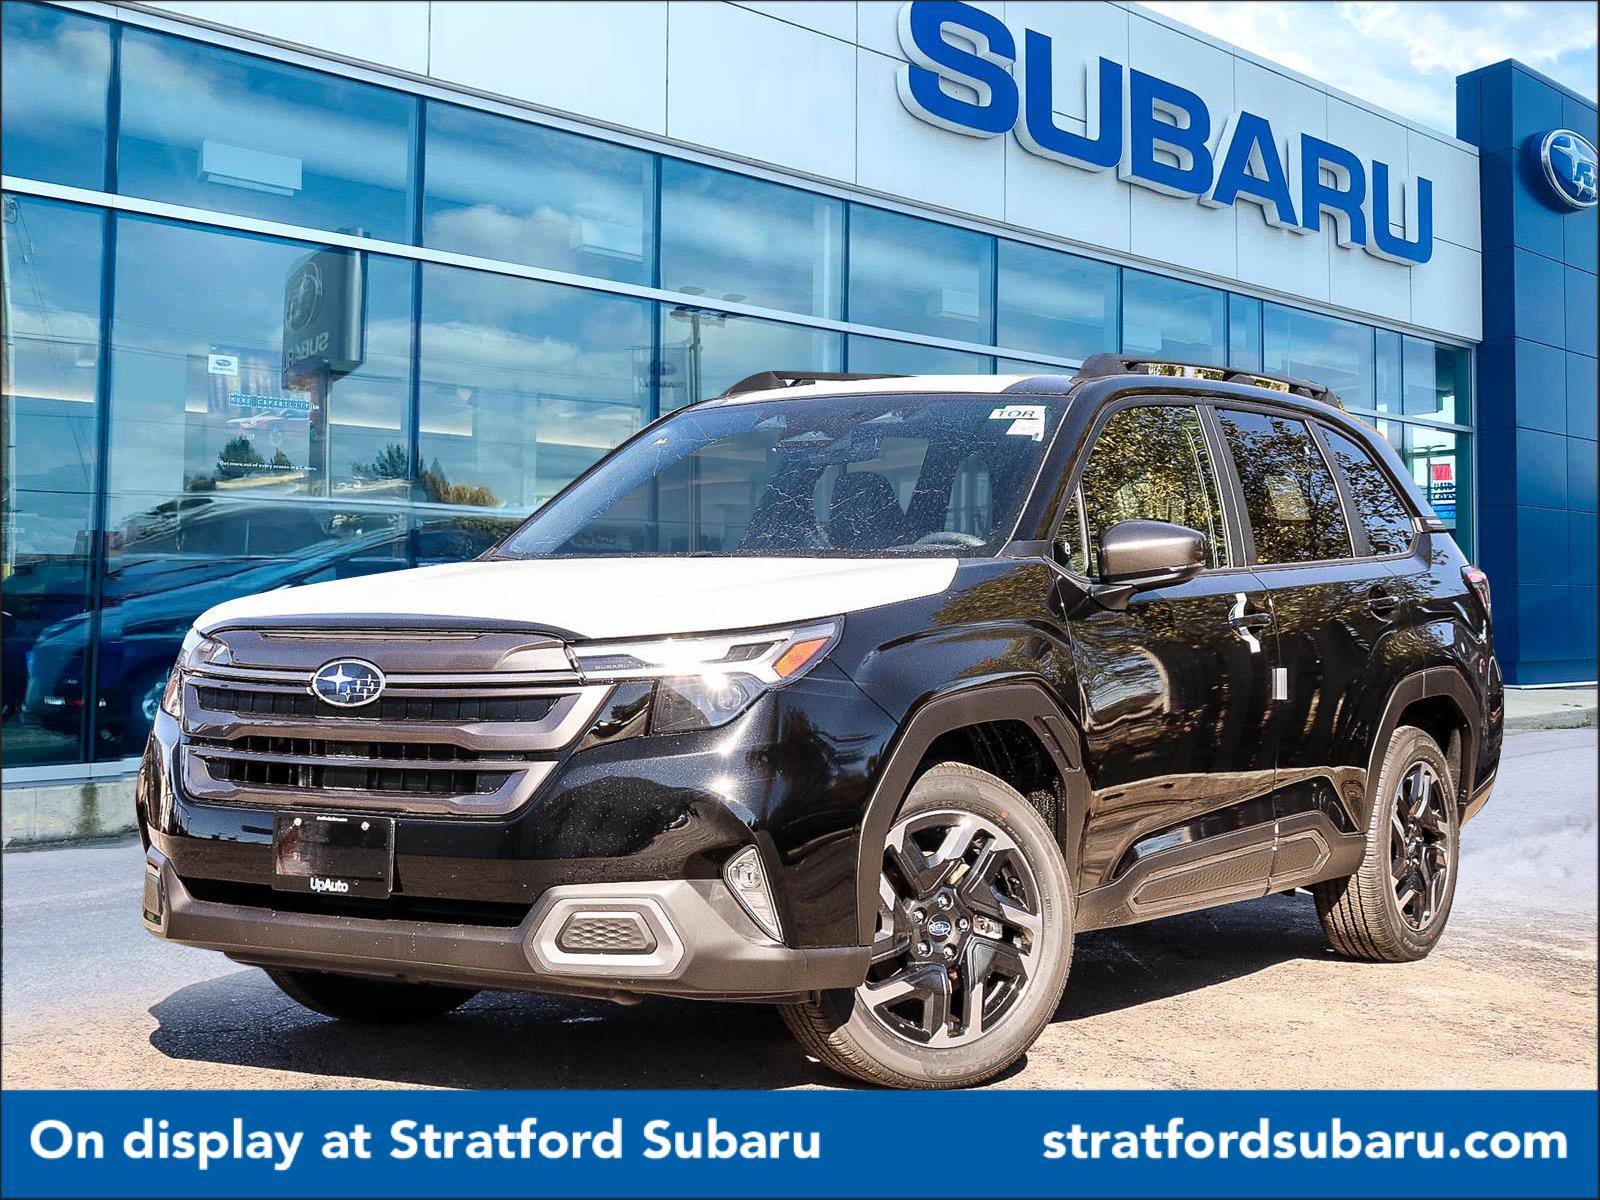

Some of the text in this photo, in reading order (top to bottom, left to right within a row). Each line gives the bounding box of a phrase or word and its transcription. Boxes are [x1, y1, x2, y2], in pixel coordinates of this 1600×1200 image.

[897, 0, 1434, 266] SUBARU
[999, 409, 1035, 418] TOR
[309, 877, 349, 893] UpAuto
